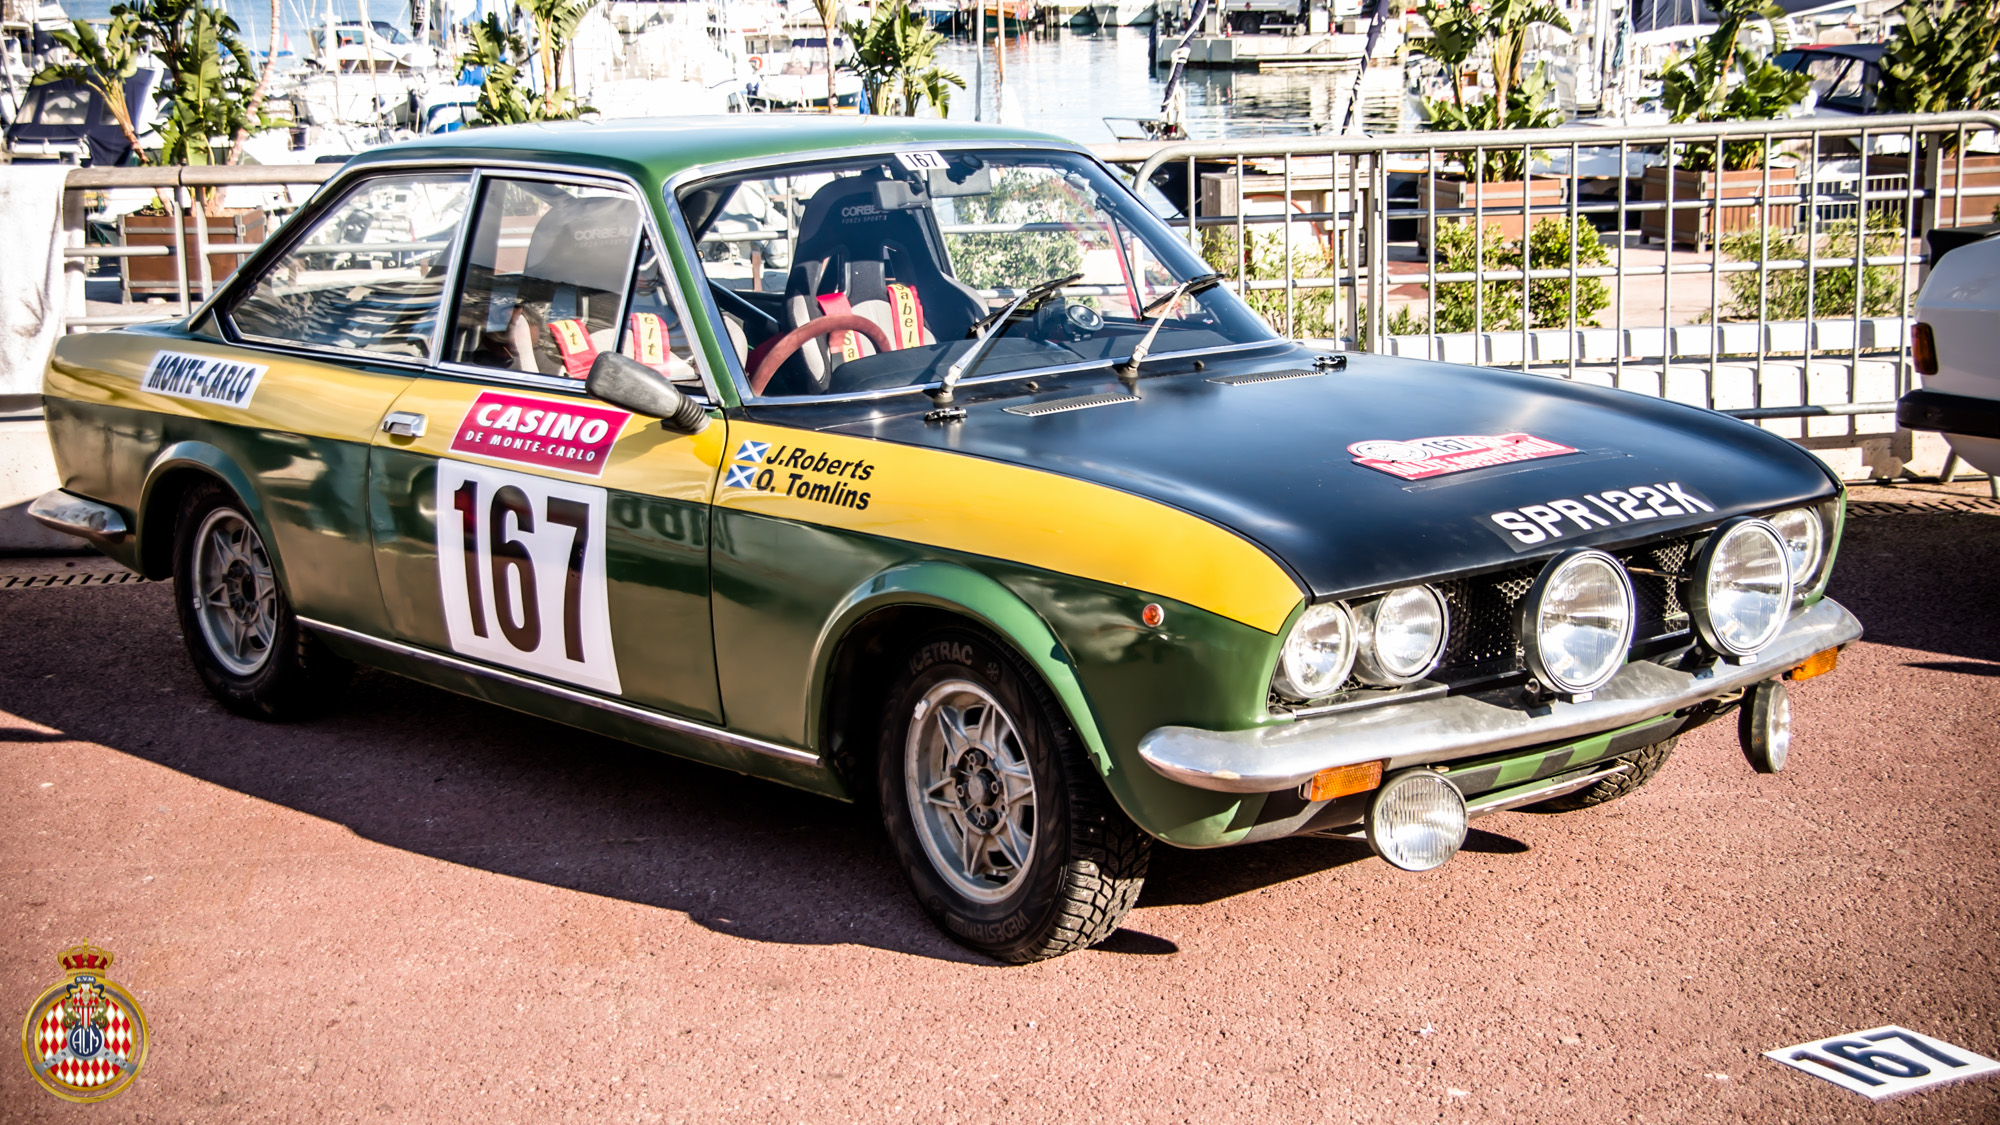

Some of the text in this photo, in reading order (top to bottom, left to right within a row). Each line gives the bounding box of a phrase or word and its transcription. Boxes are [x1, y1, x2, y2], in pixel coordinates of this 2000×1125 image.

[905, 154, 938, 168] 167
[842, 205, 889, 217] CORBE
[574, 226, 634, 240] CORBEAU
[147, 355, 257, 404] MONTE-CARLO
[476, 403, 609, 444] CASINO
[465, 430, 596, 462] DE MONTE-CARLO
[766, 445, 875, 481] J.Roberts
[1421, 439, 1474, 453] 167
[756, 469, 871, 510] O. Tomlins
[454, 479, 590, 663] 167
[908, 641, 973, 675] ICETRAC
[1789, 1030, 1971, 1087] 167
